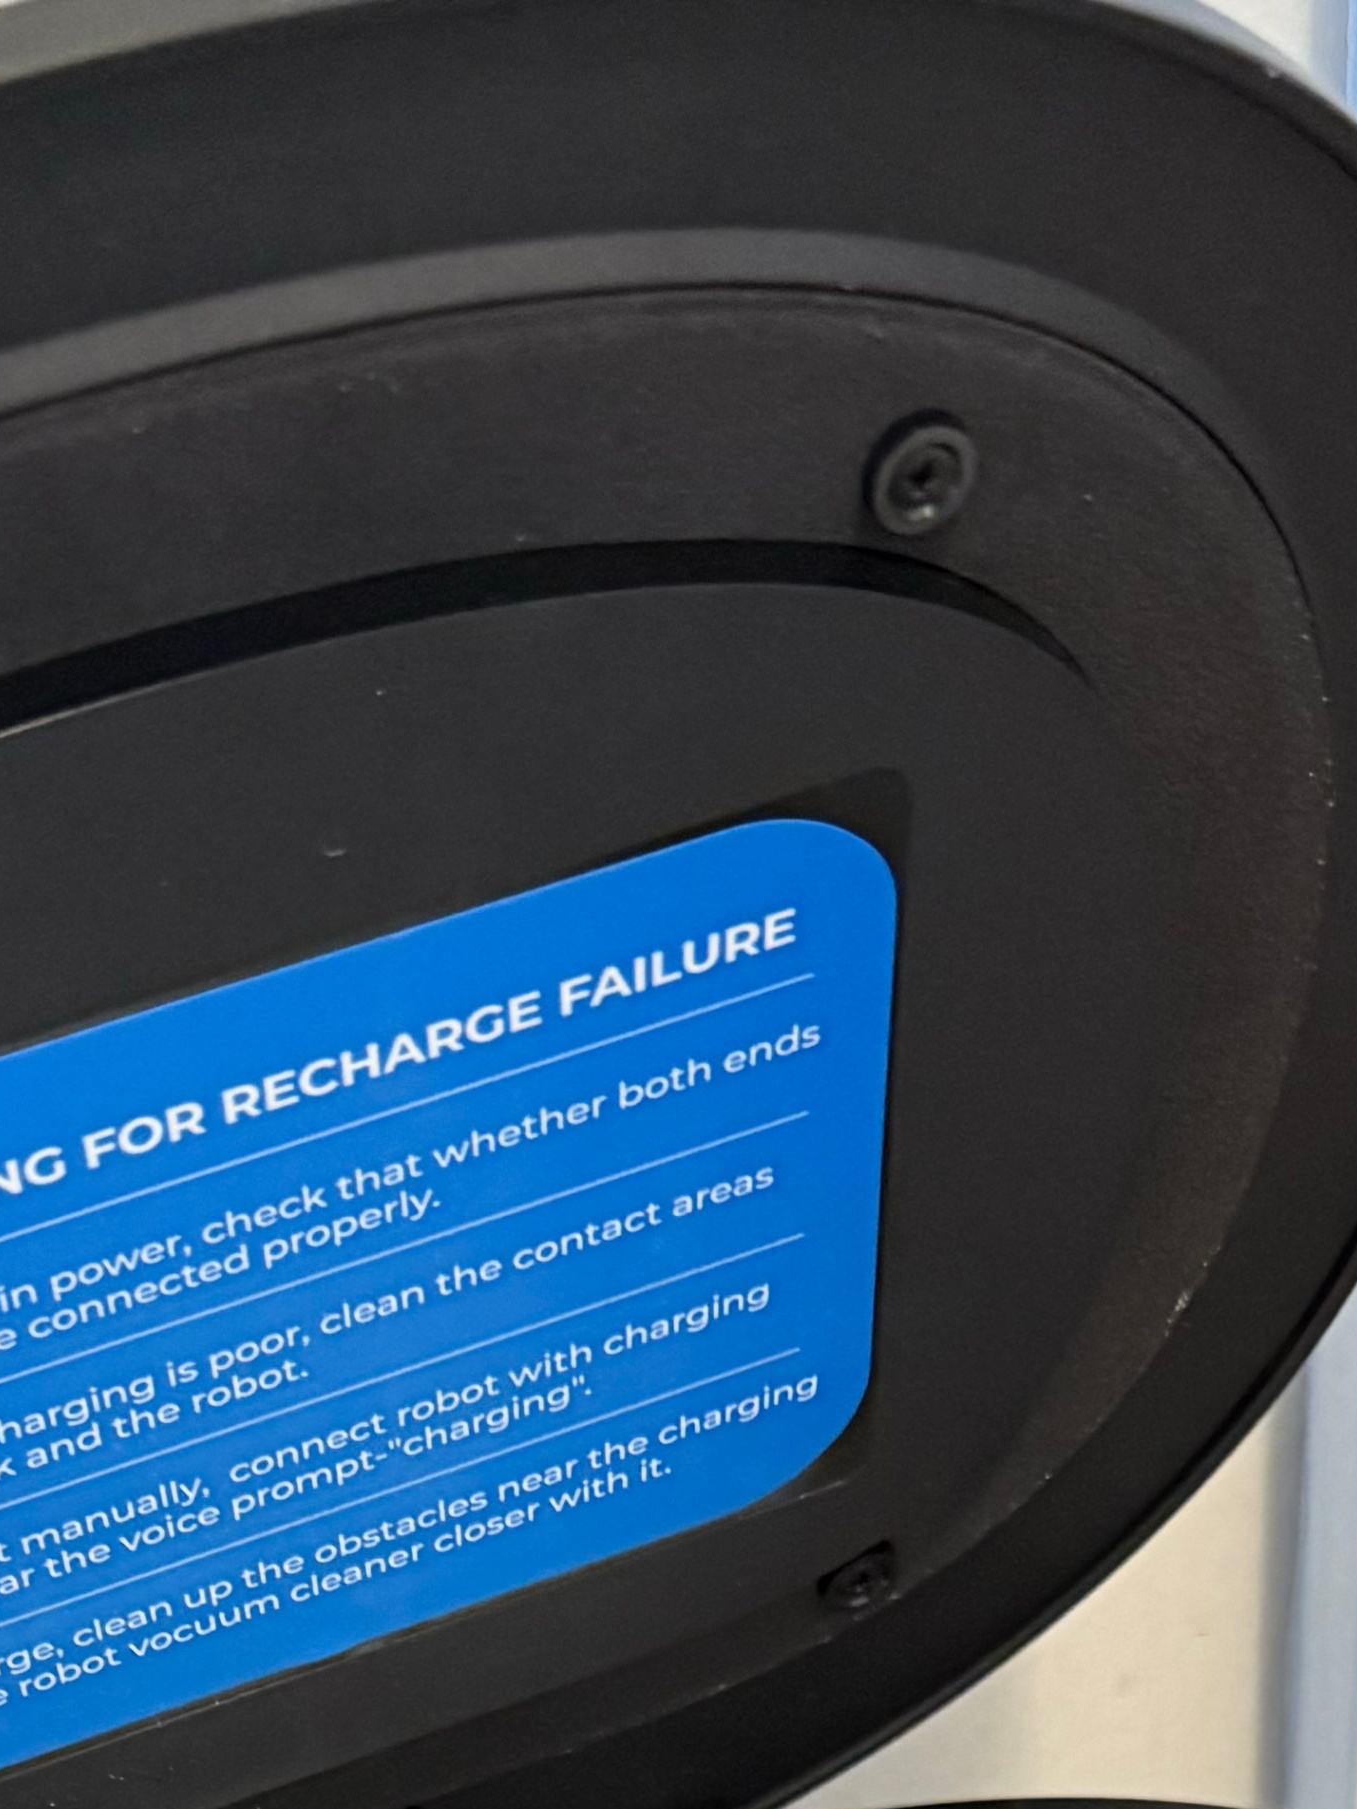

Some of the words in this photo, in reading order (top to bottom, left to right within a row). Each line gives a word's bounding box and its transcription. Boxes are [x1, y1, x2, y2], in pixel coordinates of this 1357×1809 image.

[82, 1102, 206, 1170] FOR
[221, 990, 543, 1125] RECHARGE
[559, 908, 796, 1017] FAILURE
[28, 1243, 250, 1339] connected
[263, 1189, 440, 1270] properly.
[50, 1235, 192, 1302] power,
[202, 1185, 327, 1244] check
[336, 1154, 423, 1201] that
[433, 1095, 606, 1168] whether
[619, 1059, 711, 1109] both
[723, 1025, 821, 1073] ends
[166, 1361, 199, 1387] is
[209, 1326, 310, 1379] poor,
[320, 1286, 425, 1335] clean
[435, 1260, 502, 1296] the
[513, 1203, 661, 1270] contact
[672, 1167, 774, 1217] areas
[20, 1477, 210, 1555] manually,
[229, 1414, 387, 1483] connect
[397, 1375, 500, 1427] robot
[508, 1344, 592, 1387] with
[603, 1284, 770, 1355] charging
[26, 1421, 103, 1469] and
[111, 1403, 181, 1439] the
[191, 1360, 309, 1414] robot.
[44, 1544, 111, 1578] the
[118, 1506, 220, 1552] voice
[231, 1375, 592, 1521] prompt-"charging".
[73, 1601, 173, 1647] clean
[183, 1580, 233, 1609] up
[241, 1555, 305, 1589] the
[314, 1492, 488, 1564] obstacles
[498, 1459, 578, 1502] near
[587, 1436, 648, 1470] the
[658, 1375, 818, 1445] charging
[19, 1647, 122, 1697] robot
[128, 1594, 280, 1657] vocuum
[290, 1543, 424, 1602] cleaner
[433, 1503, 540, 1553] closer
[549, 1471, 629, 1512] with
[640, 1458, 671, 1482] it.
